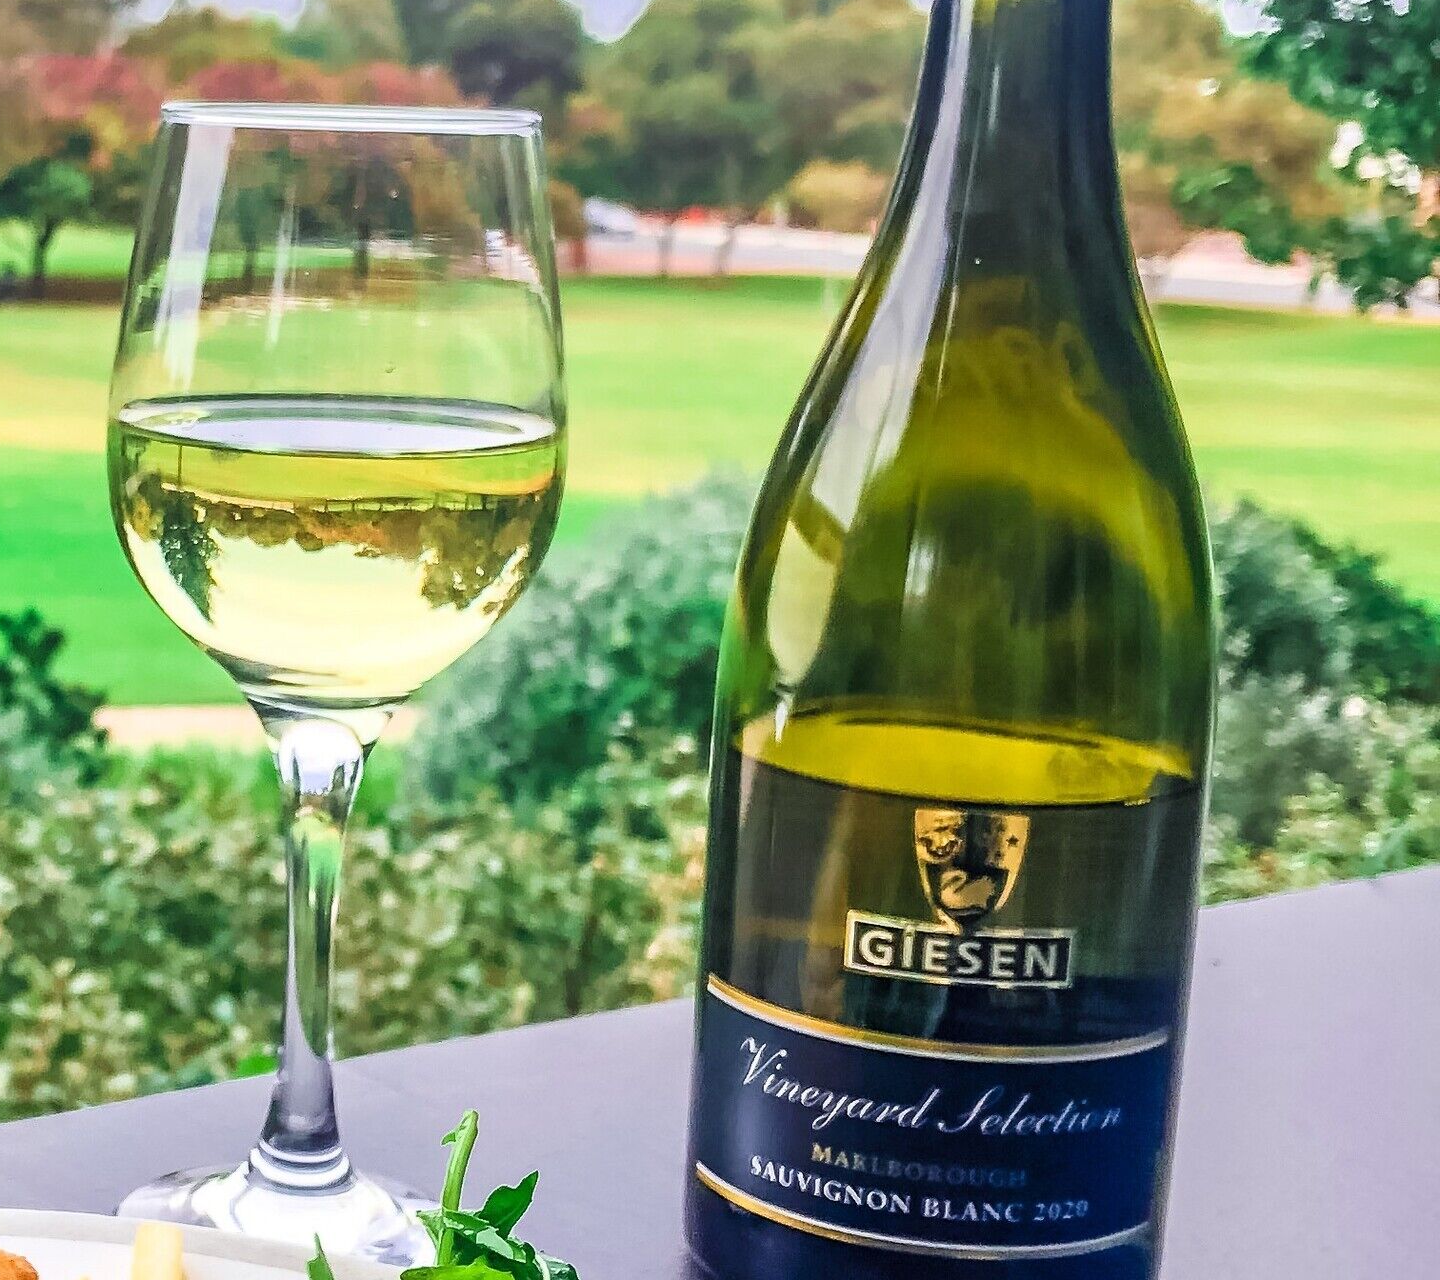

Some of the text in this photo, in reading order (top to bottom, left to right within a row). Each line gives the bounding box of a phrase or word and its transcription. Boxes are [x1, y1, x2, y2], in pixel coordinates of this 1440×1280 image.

[859, 926, 1058, 980] GIESEN
[739, 1036, 1122, 1136] Vineyard Selection
[750, 1154, 1090, 1223] SAUVIGNON BLANC 2020
[810, 1141, 1027, 1187] MARLBOROUGH
